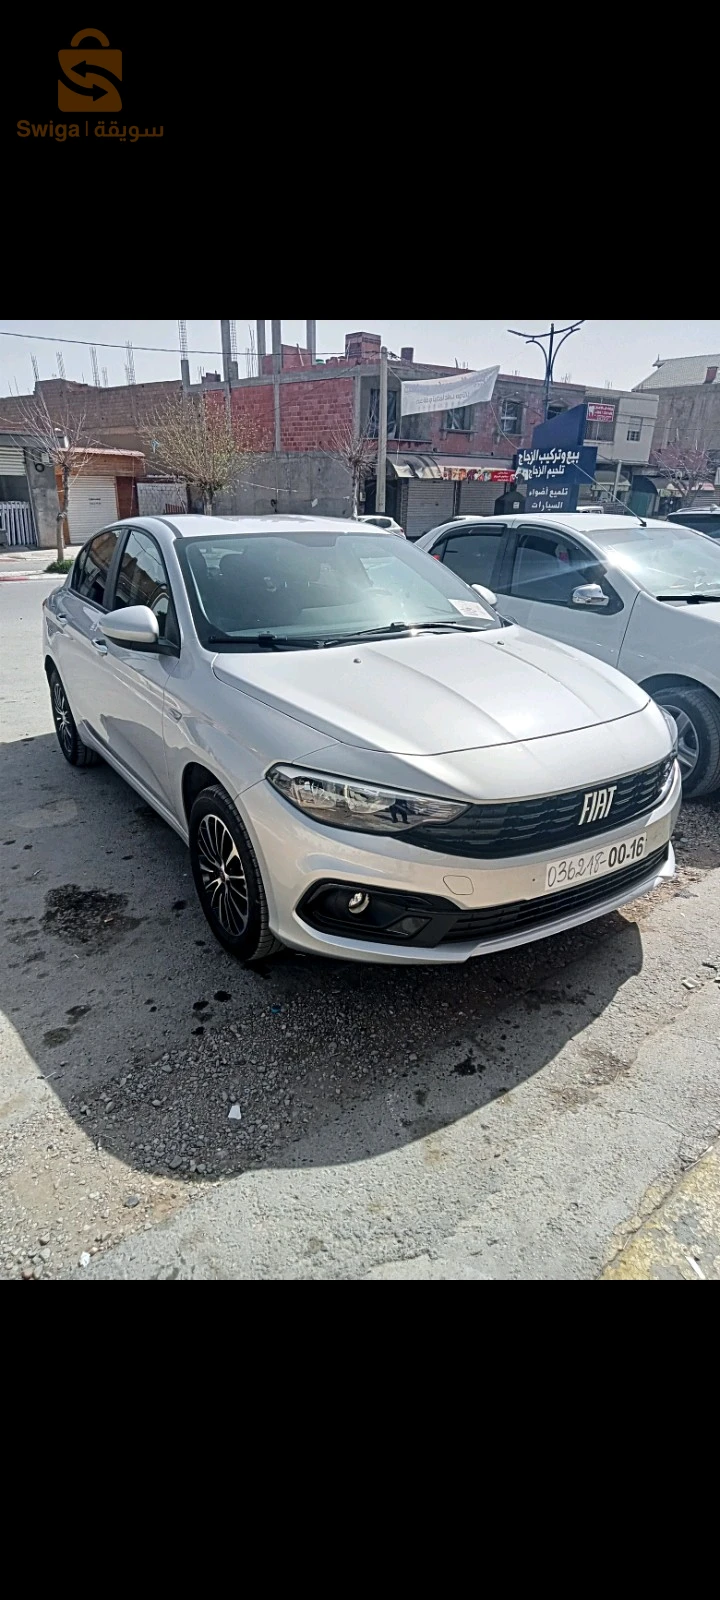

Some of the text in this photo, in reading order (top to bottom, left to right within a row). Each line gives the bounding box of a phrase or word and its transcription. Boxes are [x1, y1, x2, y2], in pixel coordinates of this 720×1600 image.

[518, 447, 580, 465] بيع وتركيب الزجاج
[528, 464, 565, 479] تلحيم الزجاج
[549, 487, 568, 498] تلميع
[531, 501, 564, 511] السيارات
[578, 785, 617, 825] FIAT
